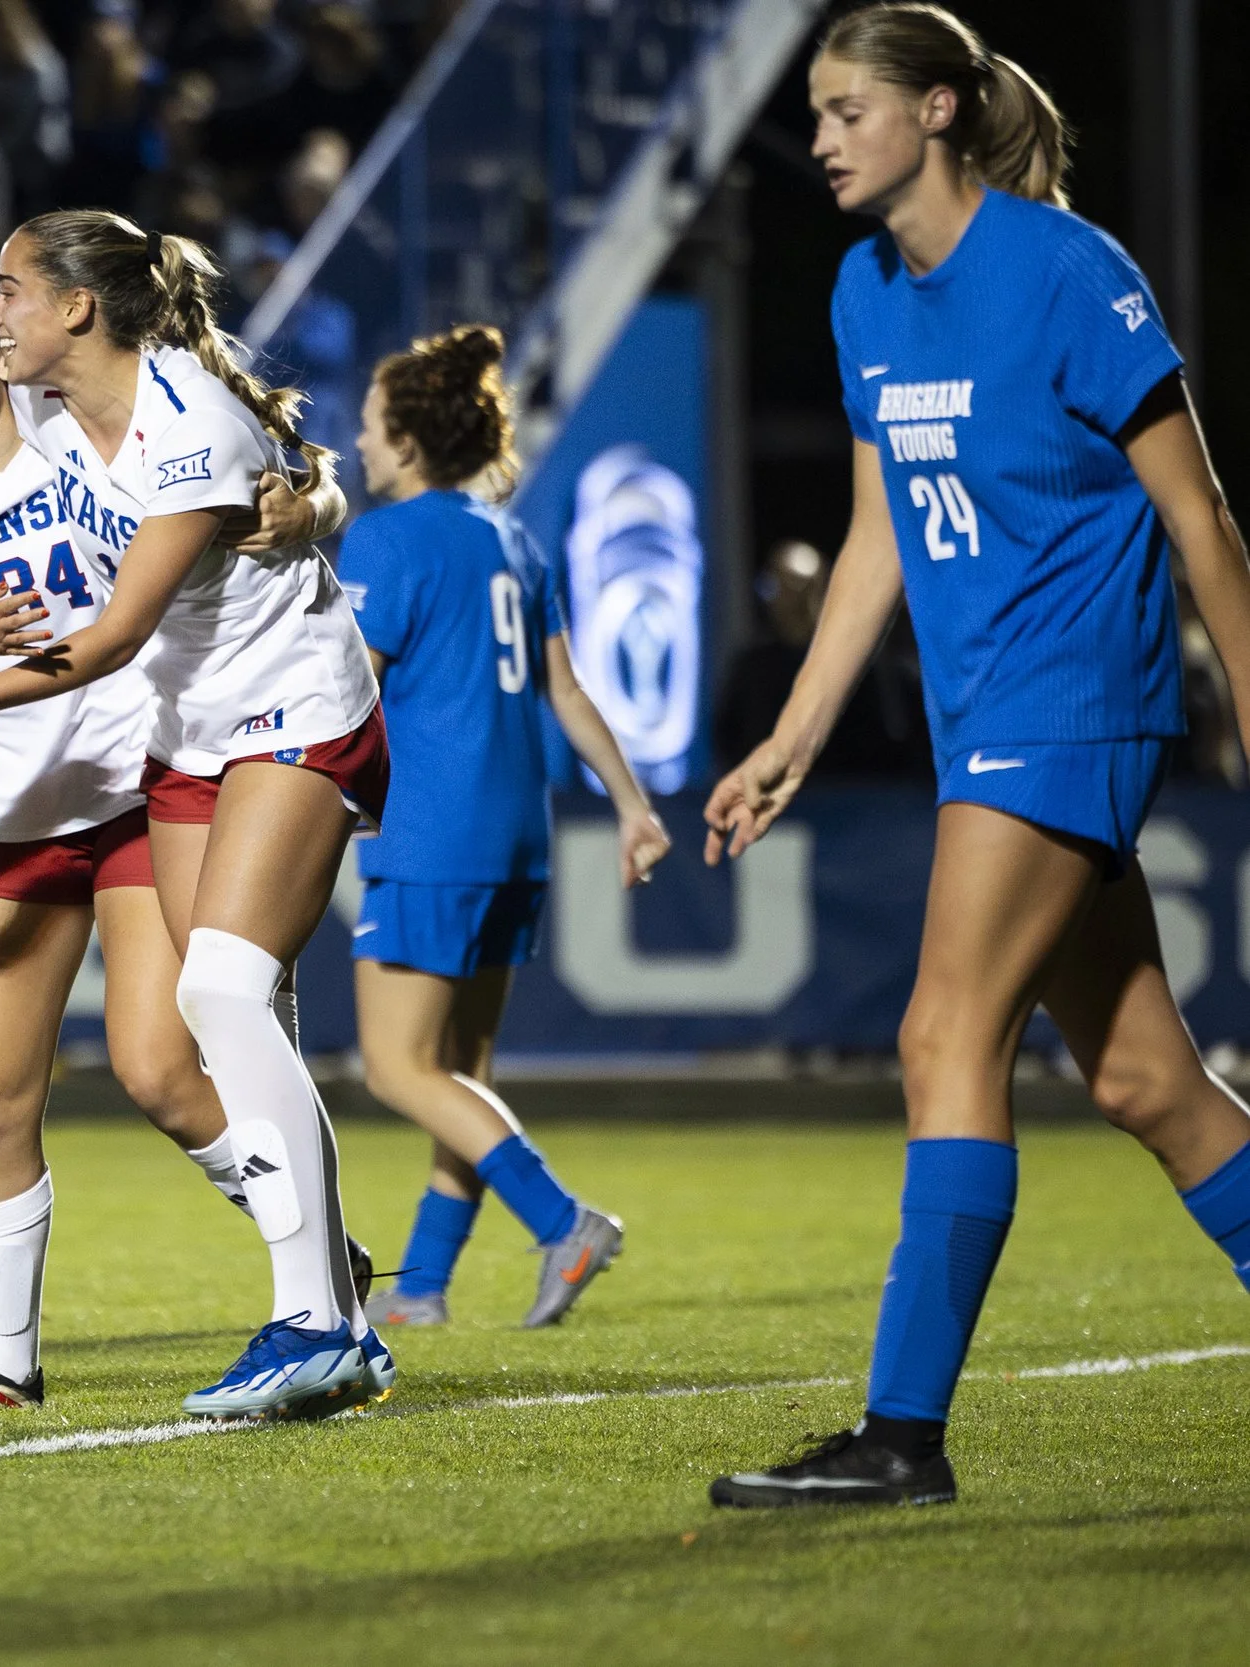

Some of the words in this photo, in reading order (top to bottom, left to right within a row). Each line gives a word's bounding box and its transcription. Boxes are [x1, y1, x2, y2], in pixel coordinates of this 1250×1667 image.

[877, 380, 974, 422] BRIGHAM
[887, 422, 958, 463] YOUNG
[908, 473, 981, 562] 24
[489, 570, 528, 695] 9
